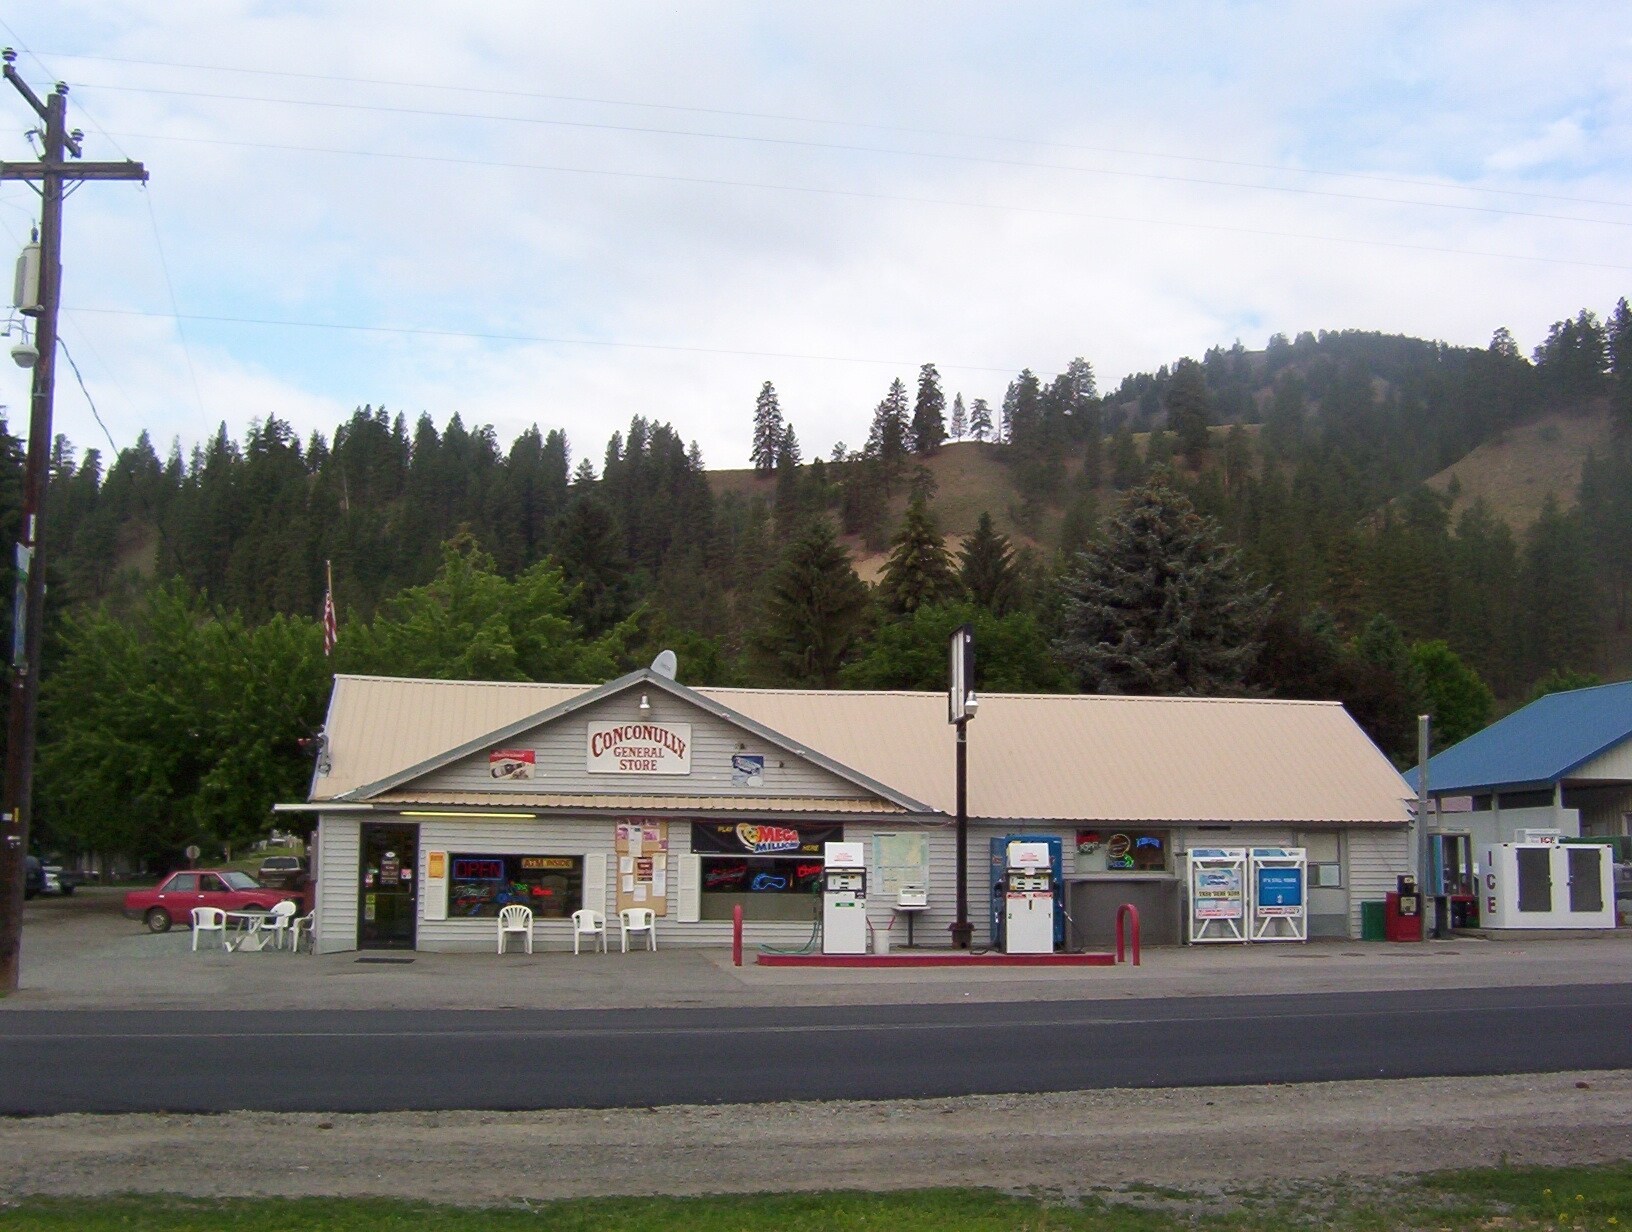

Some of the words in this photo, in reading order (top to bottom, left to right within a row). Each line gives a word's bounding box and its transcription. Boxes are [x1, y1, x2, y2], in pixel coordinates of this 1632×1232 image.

[592, 725, 686, 760] CONCONULLY
[613, 746, 665, 759] GENERAL
[619, 759, 658, 771] STORE
[717, 825, 734, 833] PLAY
[758, 825, 799, 843] MEGA
[457, 861, 500, 878] OPEN
[1486, 850, 1497, 914] ICE
